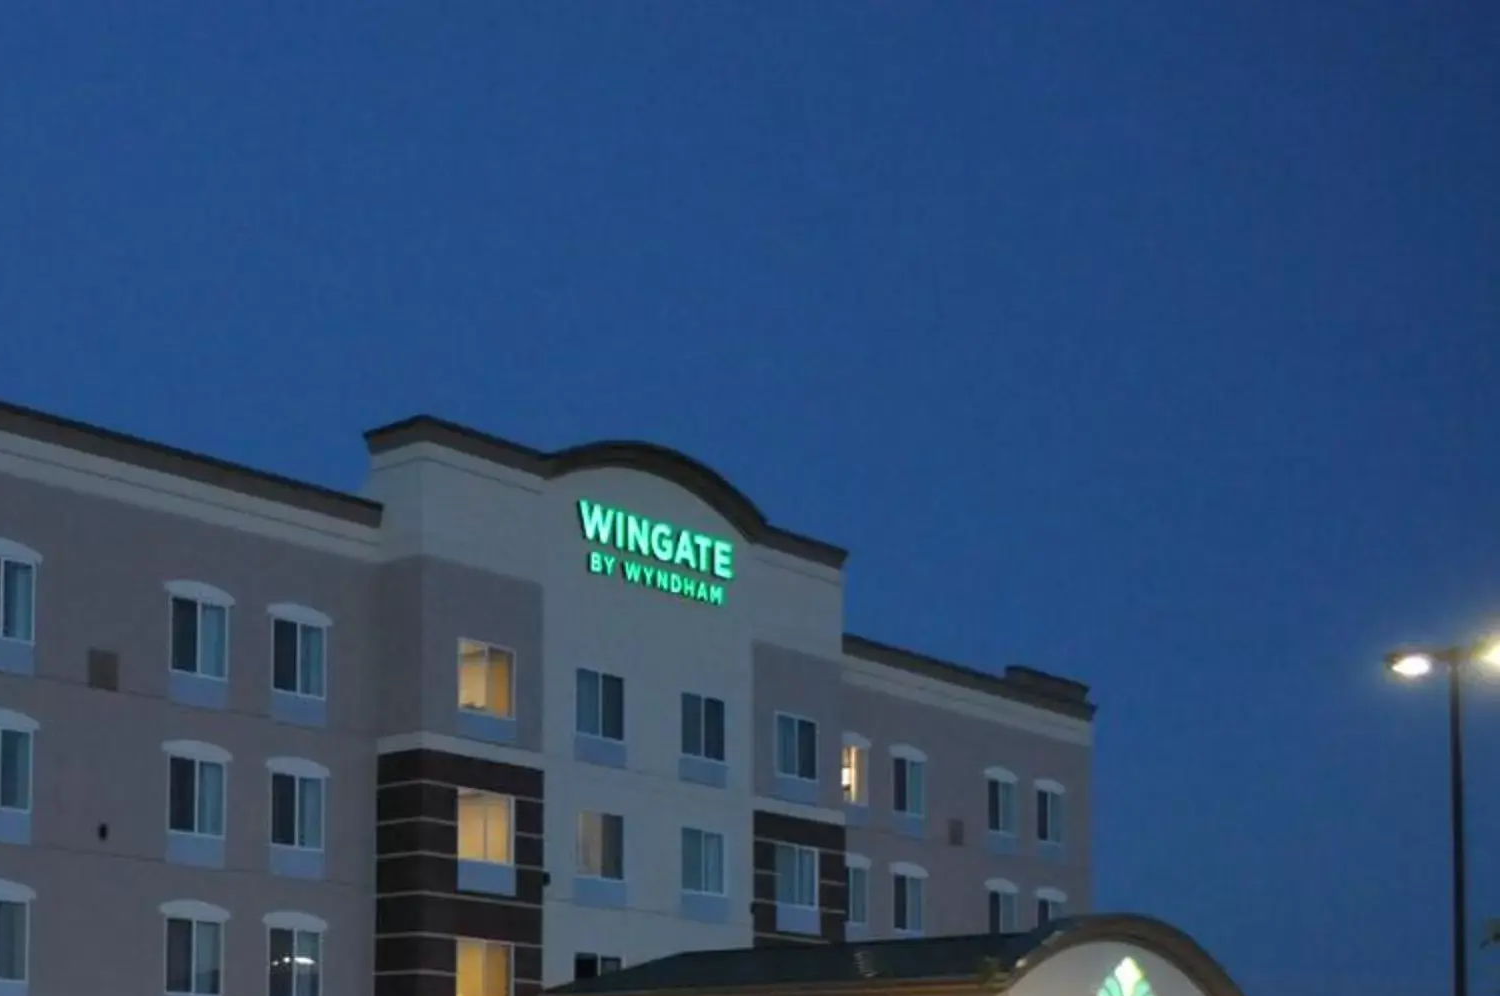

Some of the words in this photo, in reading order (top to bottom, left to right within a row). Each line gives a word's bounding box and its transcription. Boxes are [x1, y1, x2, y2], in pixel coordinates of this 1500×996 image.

[579, 499, 733, 580] WINGATE
[589, 551, 616, 577] BY
[623, 560, 724, 605] WYNDHAM
